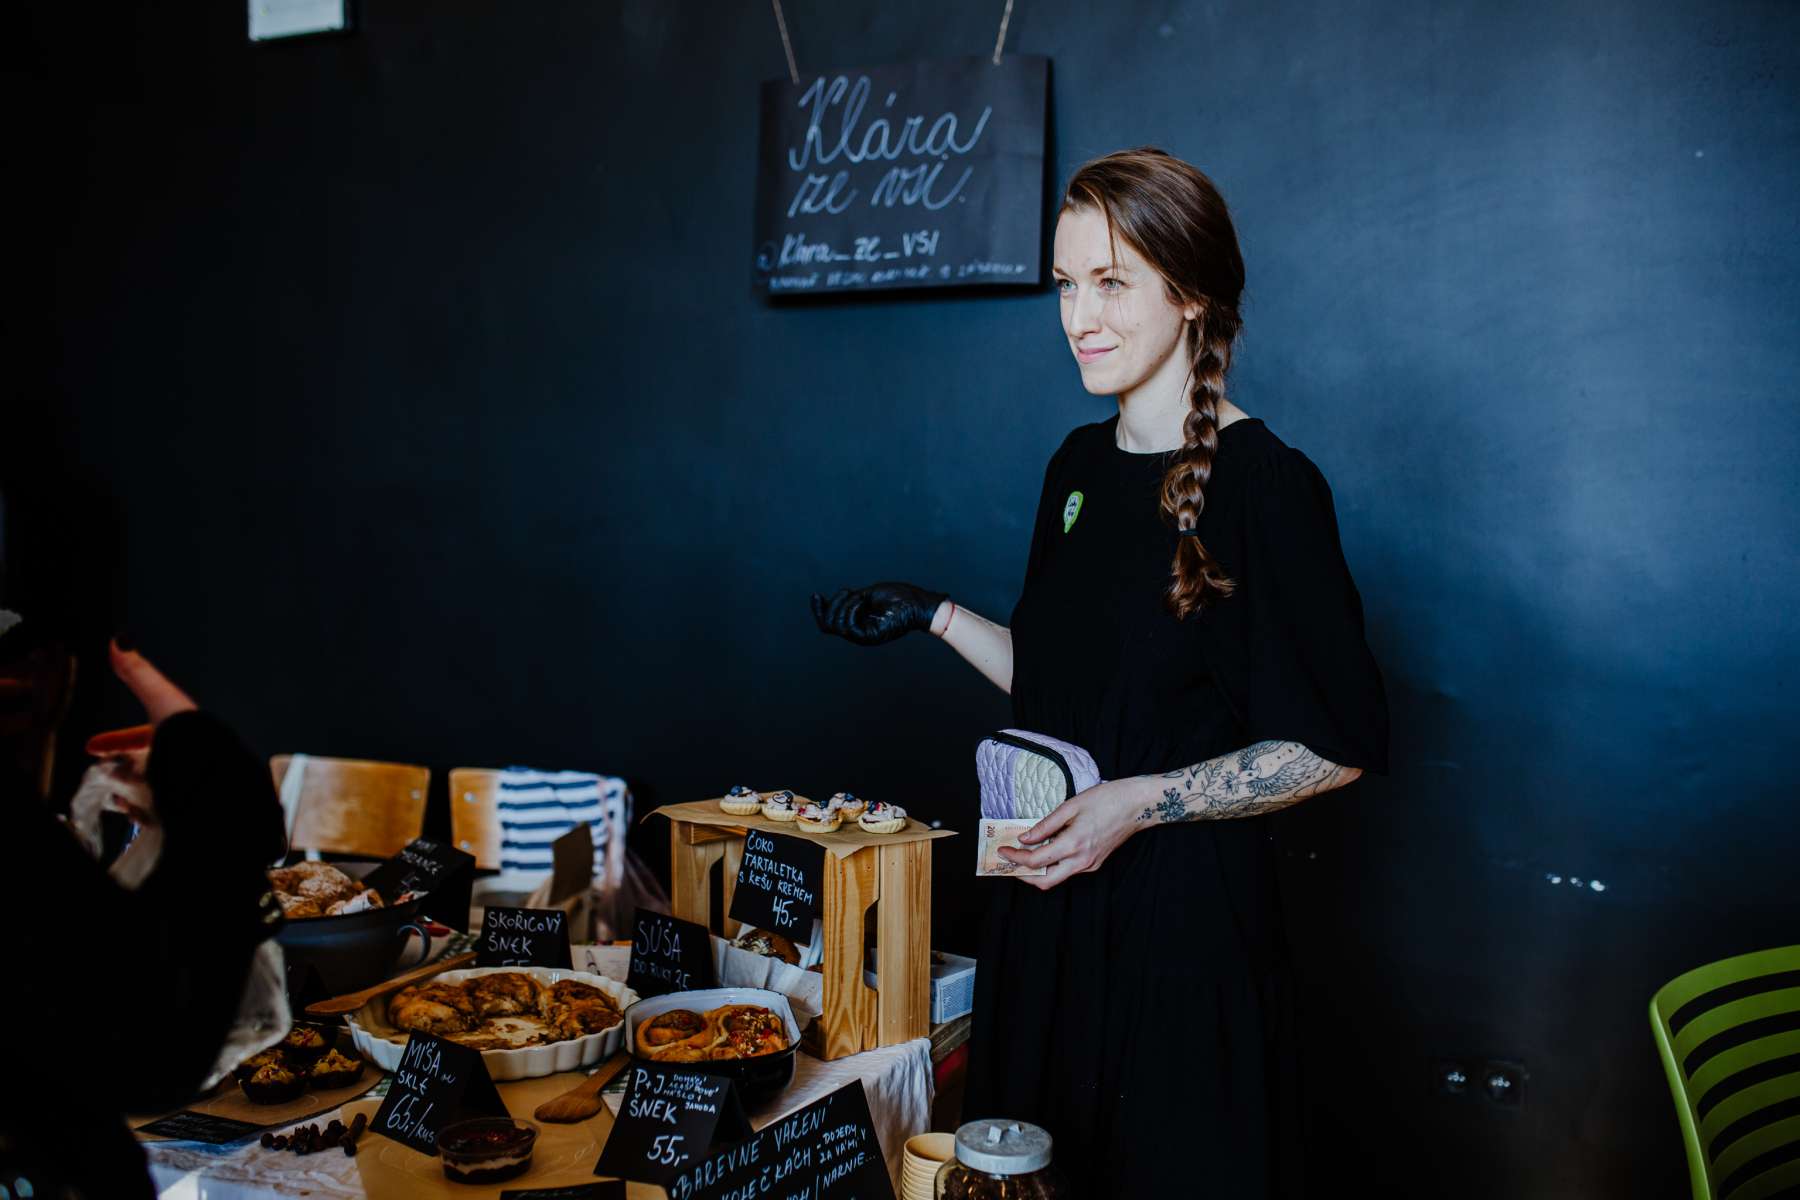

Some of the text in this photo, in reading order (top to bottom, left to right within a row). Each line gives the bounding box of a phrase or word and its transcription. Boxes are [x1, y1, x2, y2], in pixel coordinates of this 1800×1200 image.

[788, 75, 992, 172] Klára
[747, 830, 774, 855] ČOKO
[744, 852, 804, 886] TARTALETKA
[738, 870, 813, 906] S KEŠU KRÉMEM
[488, 909, 562, 934] SKOŘICOVÝ
[772, 895, 798, 927] 45,-
[488, 931, 533, 957] ŠNEK
[403, 1039, 441, 1078] MÍŠA
[397, 1070, 429, 1096] SKLE
[629, 1093, 677, 1125] ŠNEK
[647, 1135, 689, 1168] 55,-
[676, 1132, 765, 1200] BAREVNÉ
